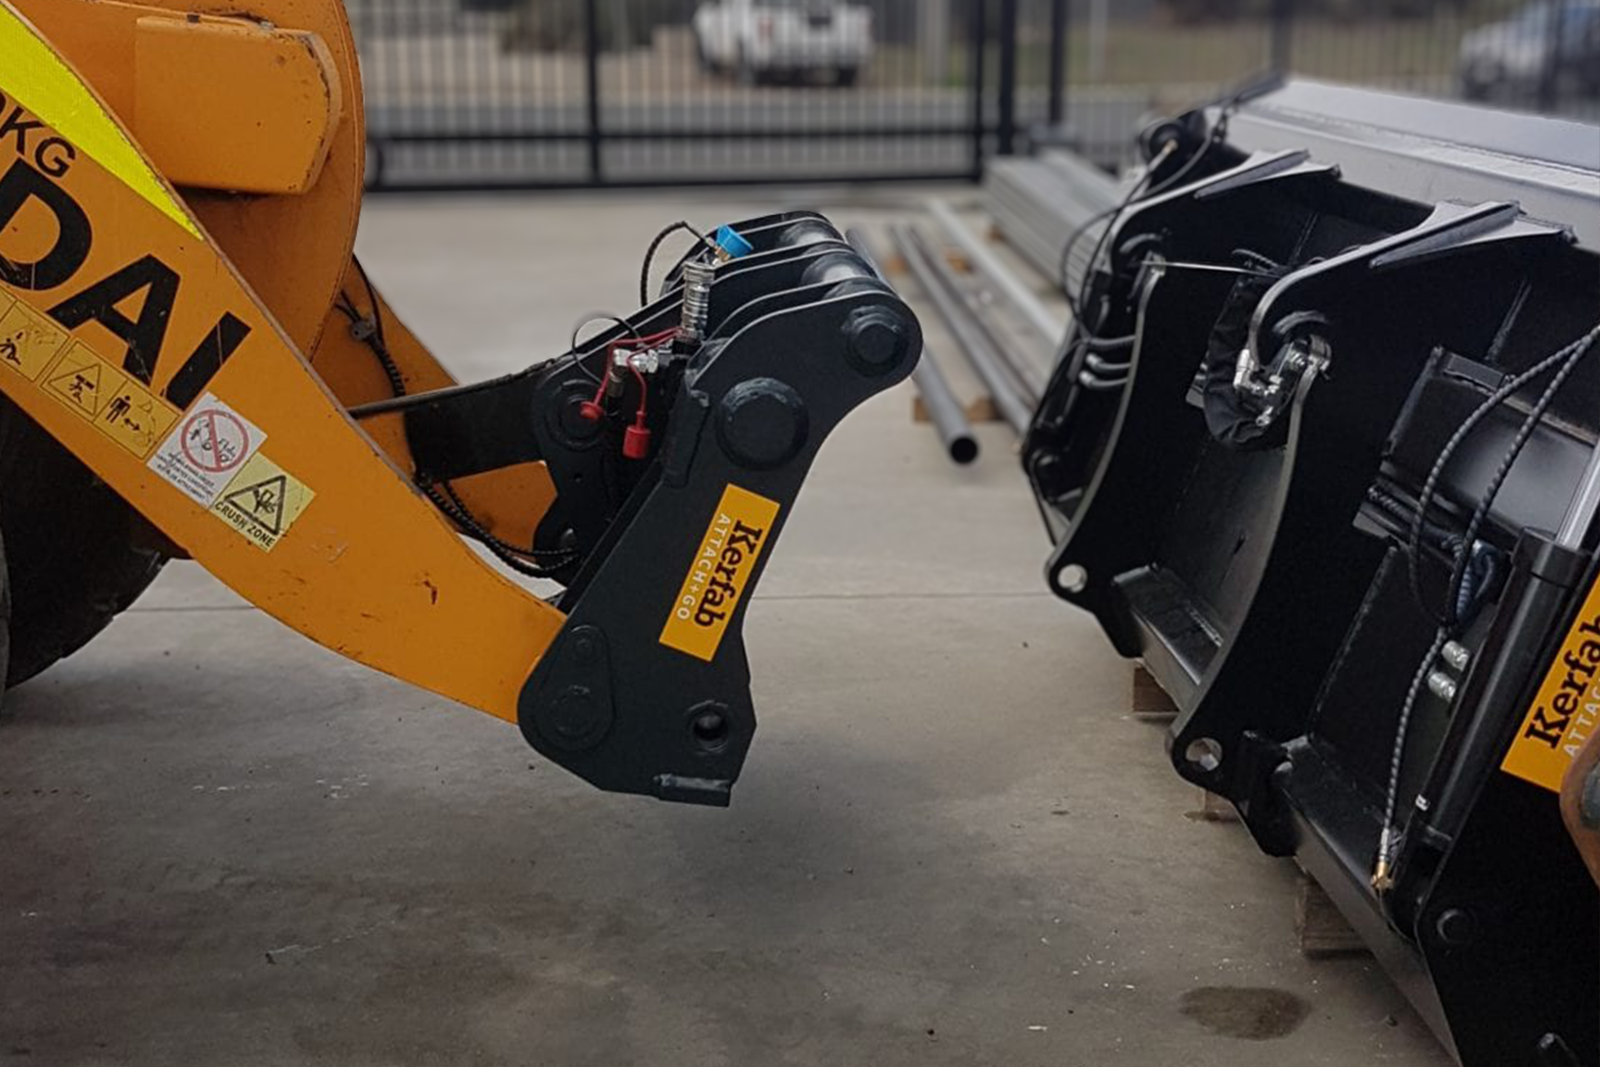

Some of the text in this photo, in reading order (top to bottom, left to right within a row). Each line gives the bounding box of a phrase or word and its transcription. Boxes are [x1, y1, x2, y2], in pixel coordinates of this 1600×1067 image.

[0, 91, 76, 178] KG
[215, 502, 275, 547] CRUSH ZONE
[695, 521, 762, 626] Kerfab
